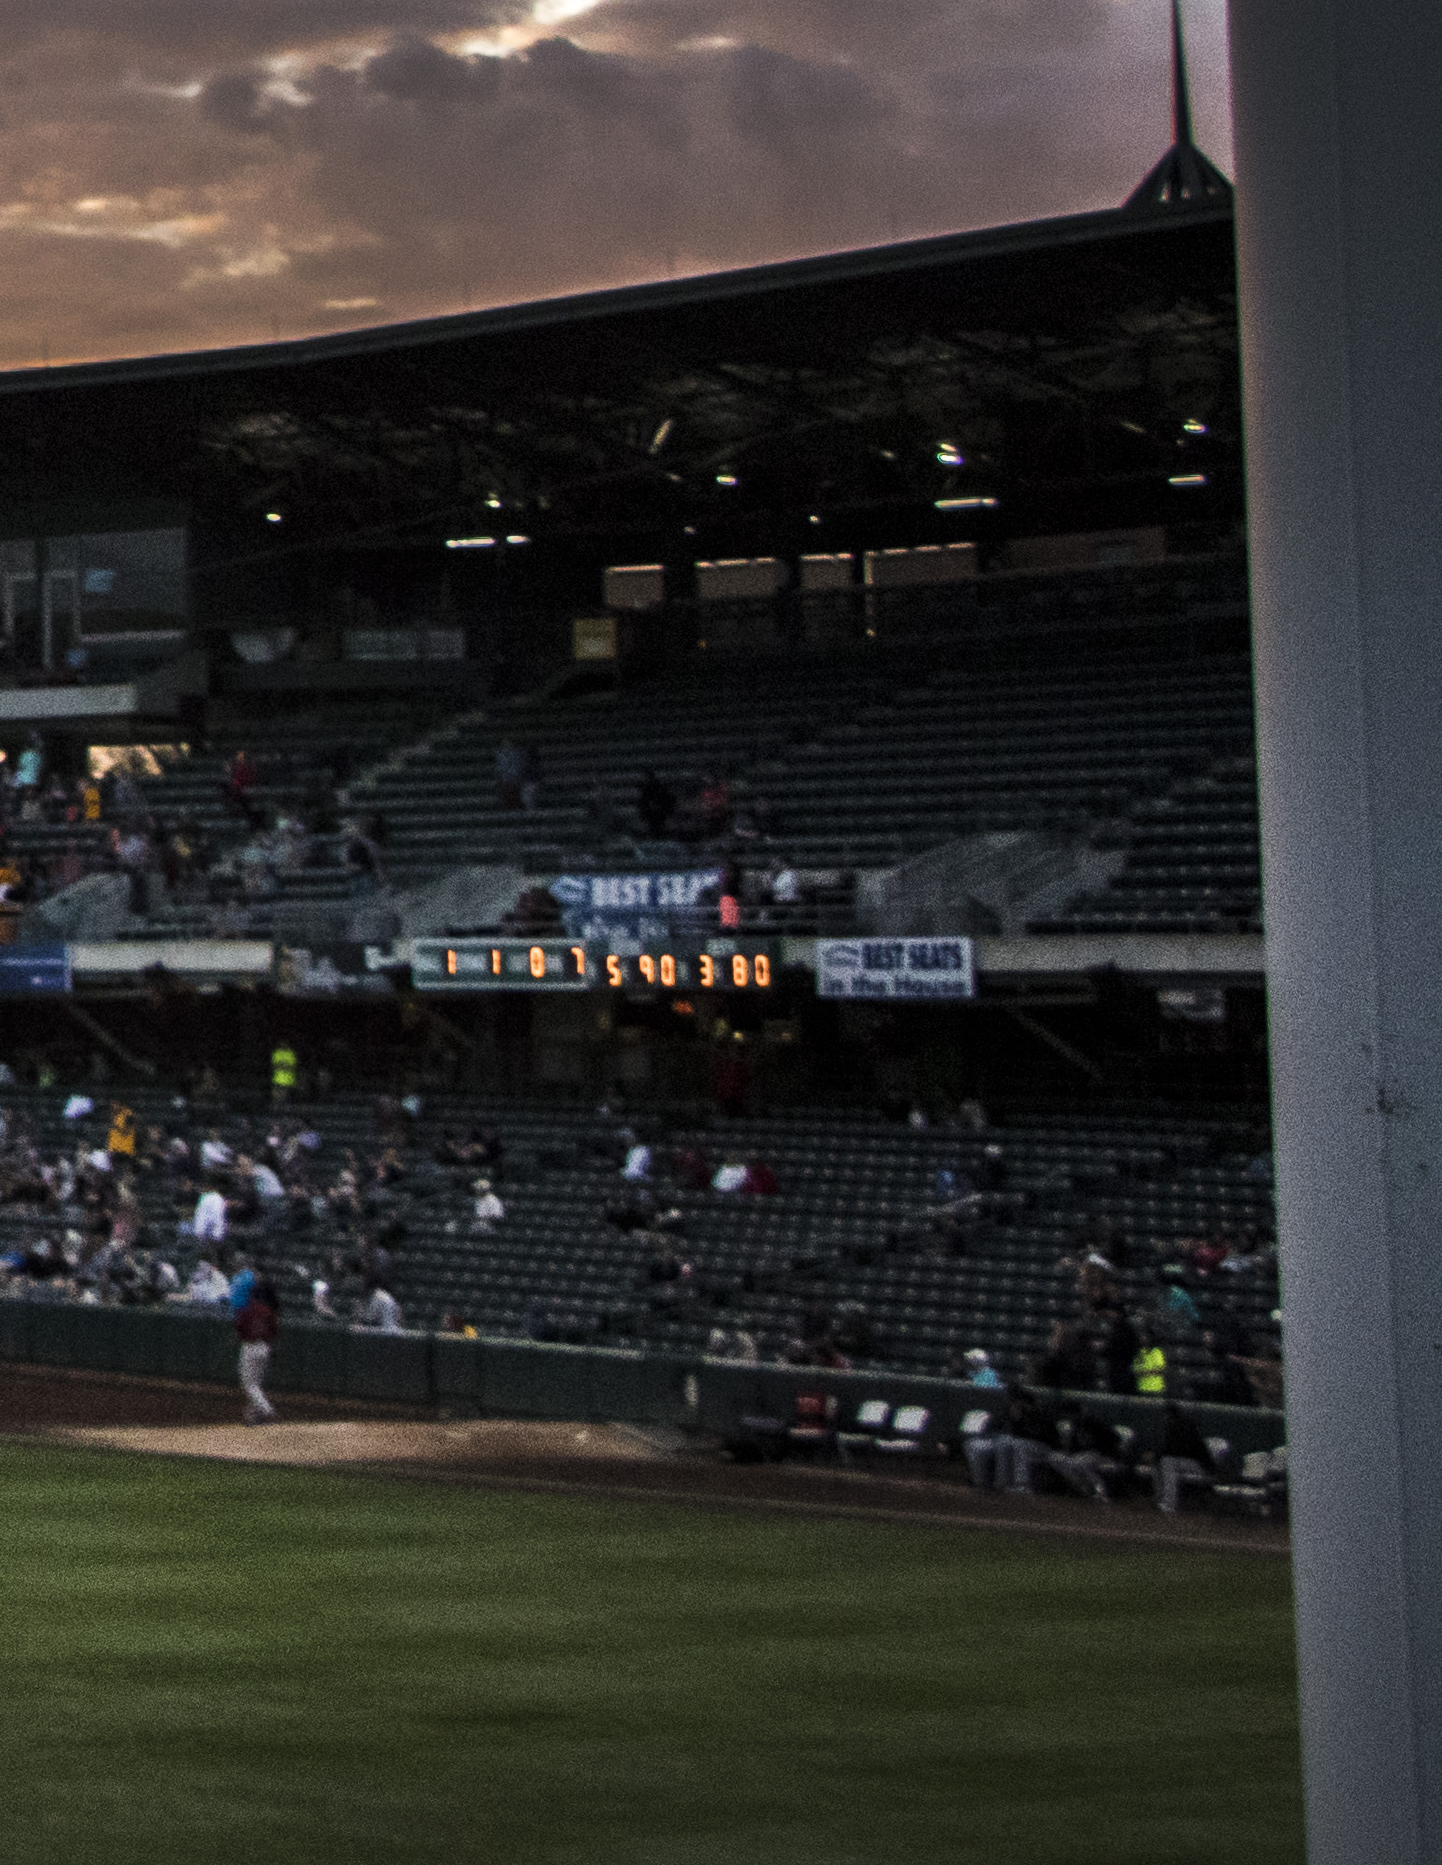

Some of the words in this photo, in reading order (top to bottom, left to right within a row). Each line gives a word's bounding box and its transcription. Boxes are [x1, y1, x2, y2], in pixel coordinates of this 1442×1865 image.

[591, 876, 652, 907] BEST
[447, 949, 457, 975] 1
[491, 949, 502, 975] 1
[529, 946, 546, 978] 0
[571, 947, 585, 975] 7
[863, 942, 904, 969] BEST
[908, 942, 962, 969] SEATS
